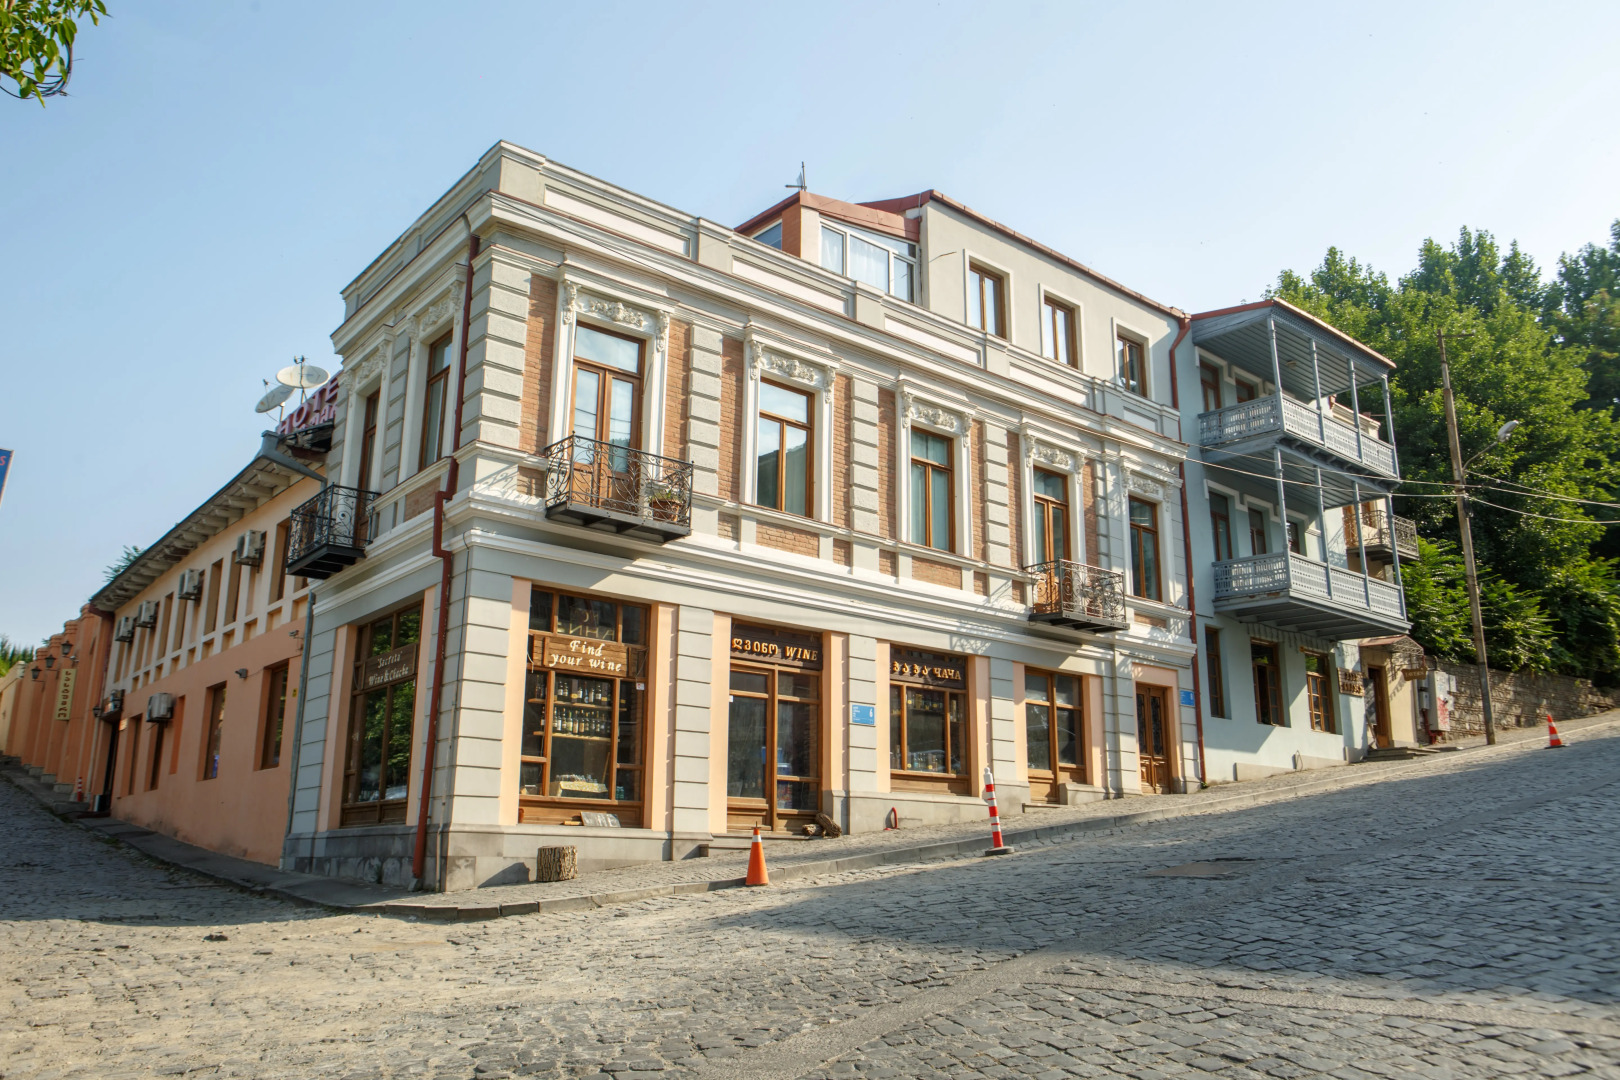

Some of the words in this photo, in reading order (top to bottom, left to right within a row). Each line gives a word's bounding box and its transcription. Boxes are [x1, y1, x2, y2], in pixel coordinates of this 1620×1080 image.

[276, 373, 340, 435] HOTE
[570, 640, 605, 657] Find
[732, 638, 778, 655] ღვინო
[785, 646, 818, 661] WINE
[549, 653, 583, 667] your
[589, 657, 622, 672] wine
[933, 667, 961, 680] ЧАЧА
